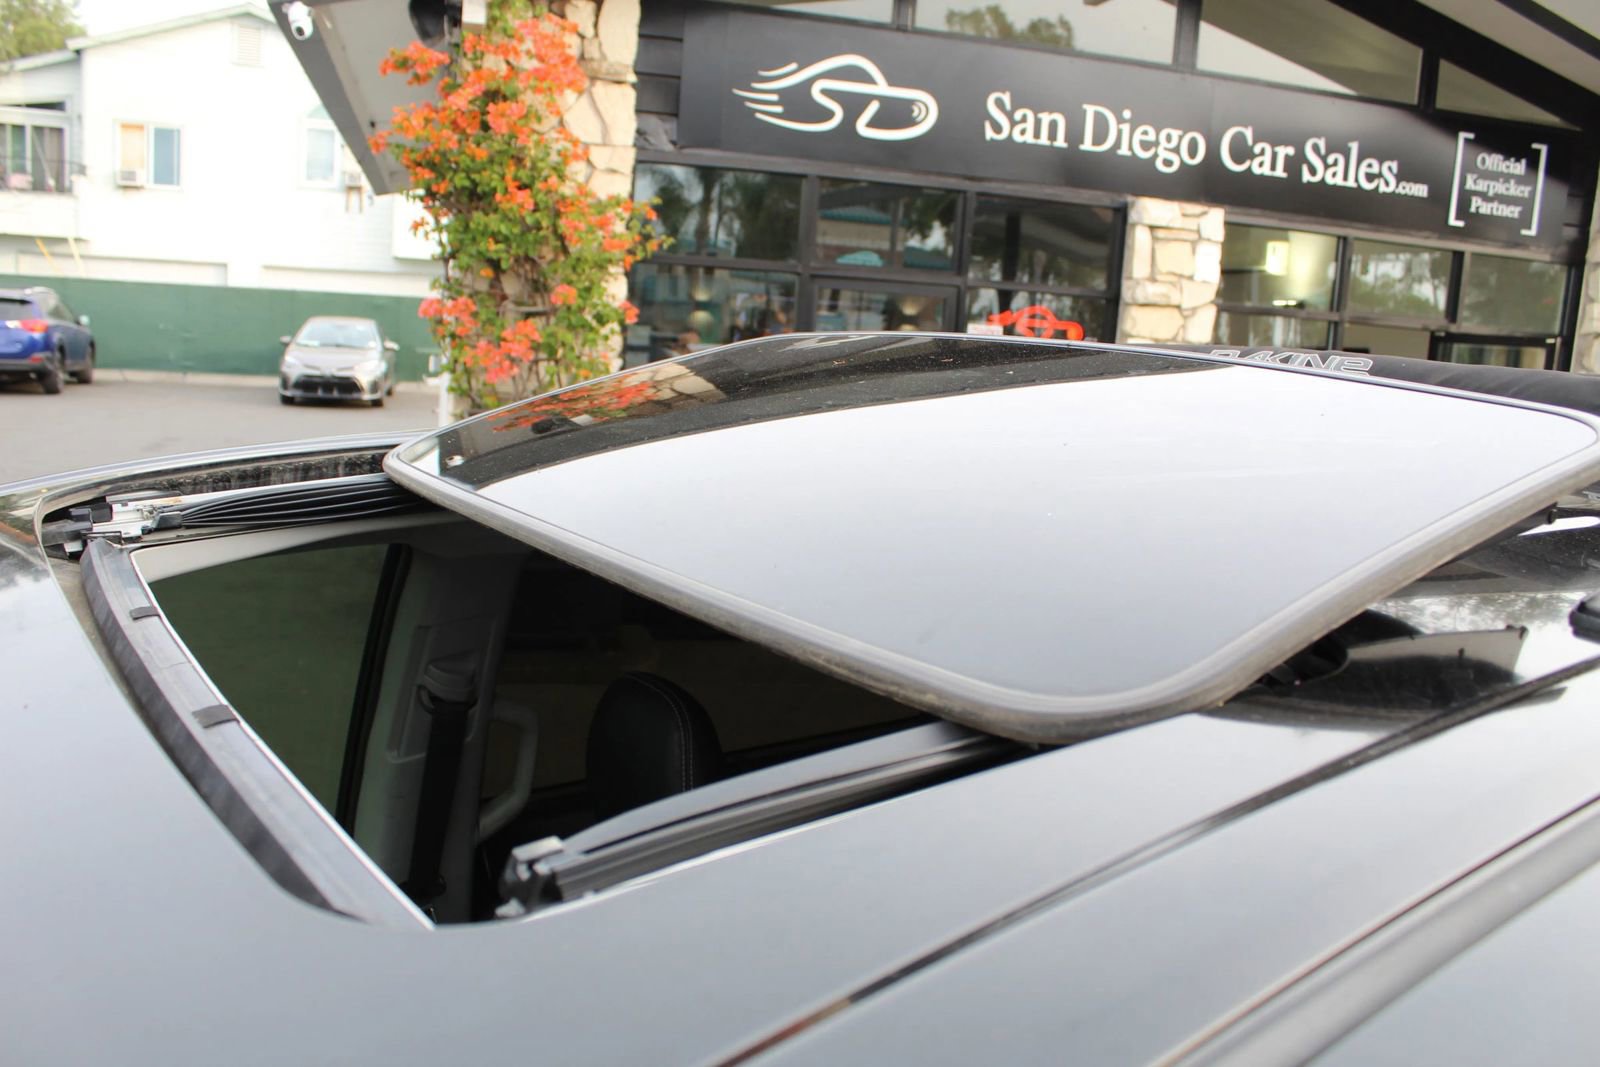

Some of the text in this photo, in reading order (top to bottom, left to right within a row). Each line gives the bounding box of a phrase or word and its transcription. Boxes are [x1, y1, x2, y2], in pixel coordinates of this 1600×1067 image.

[984, 91, 1068, 148] San
[1079, 104, 1206, 174] Diego
[1219, 126, 1295, 178] Car
[1476, 152, 1527, 176] Official
[1464, 173, 1533, 198] Karpicker
[1469, 195, 1523, 219] Partner
